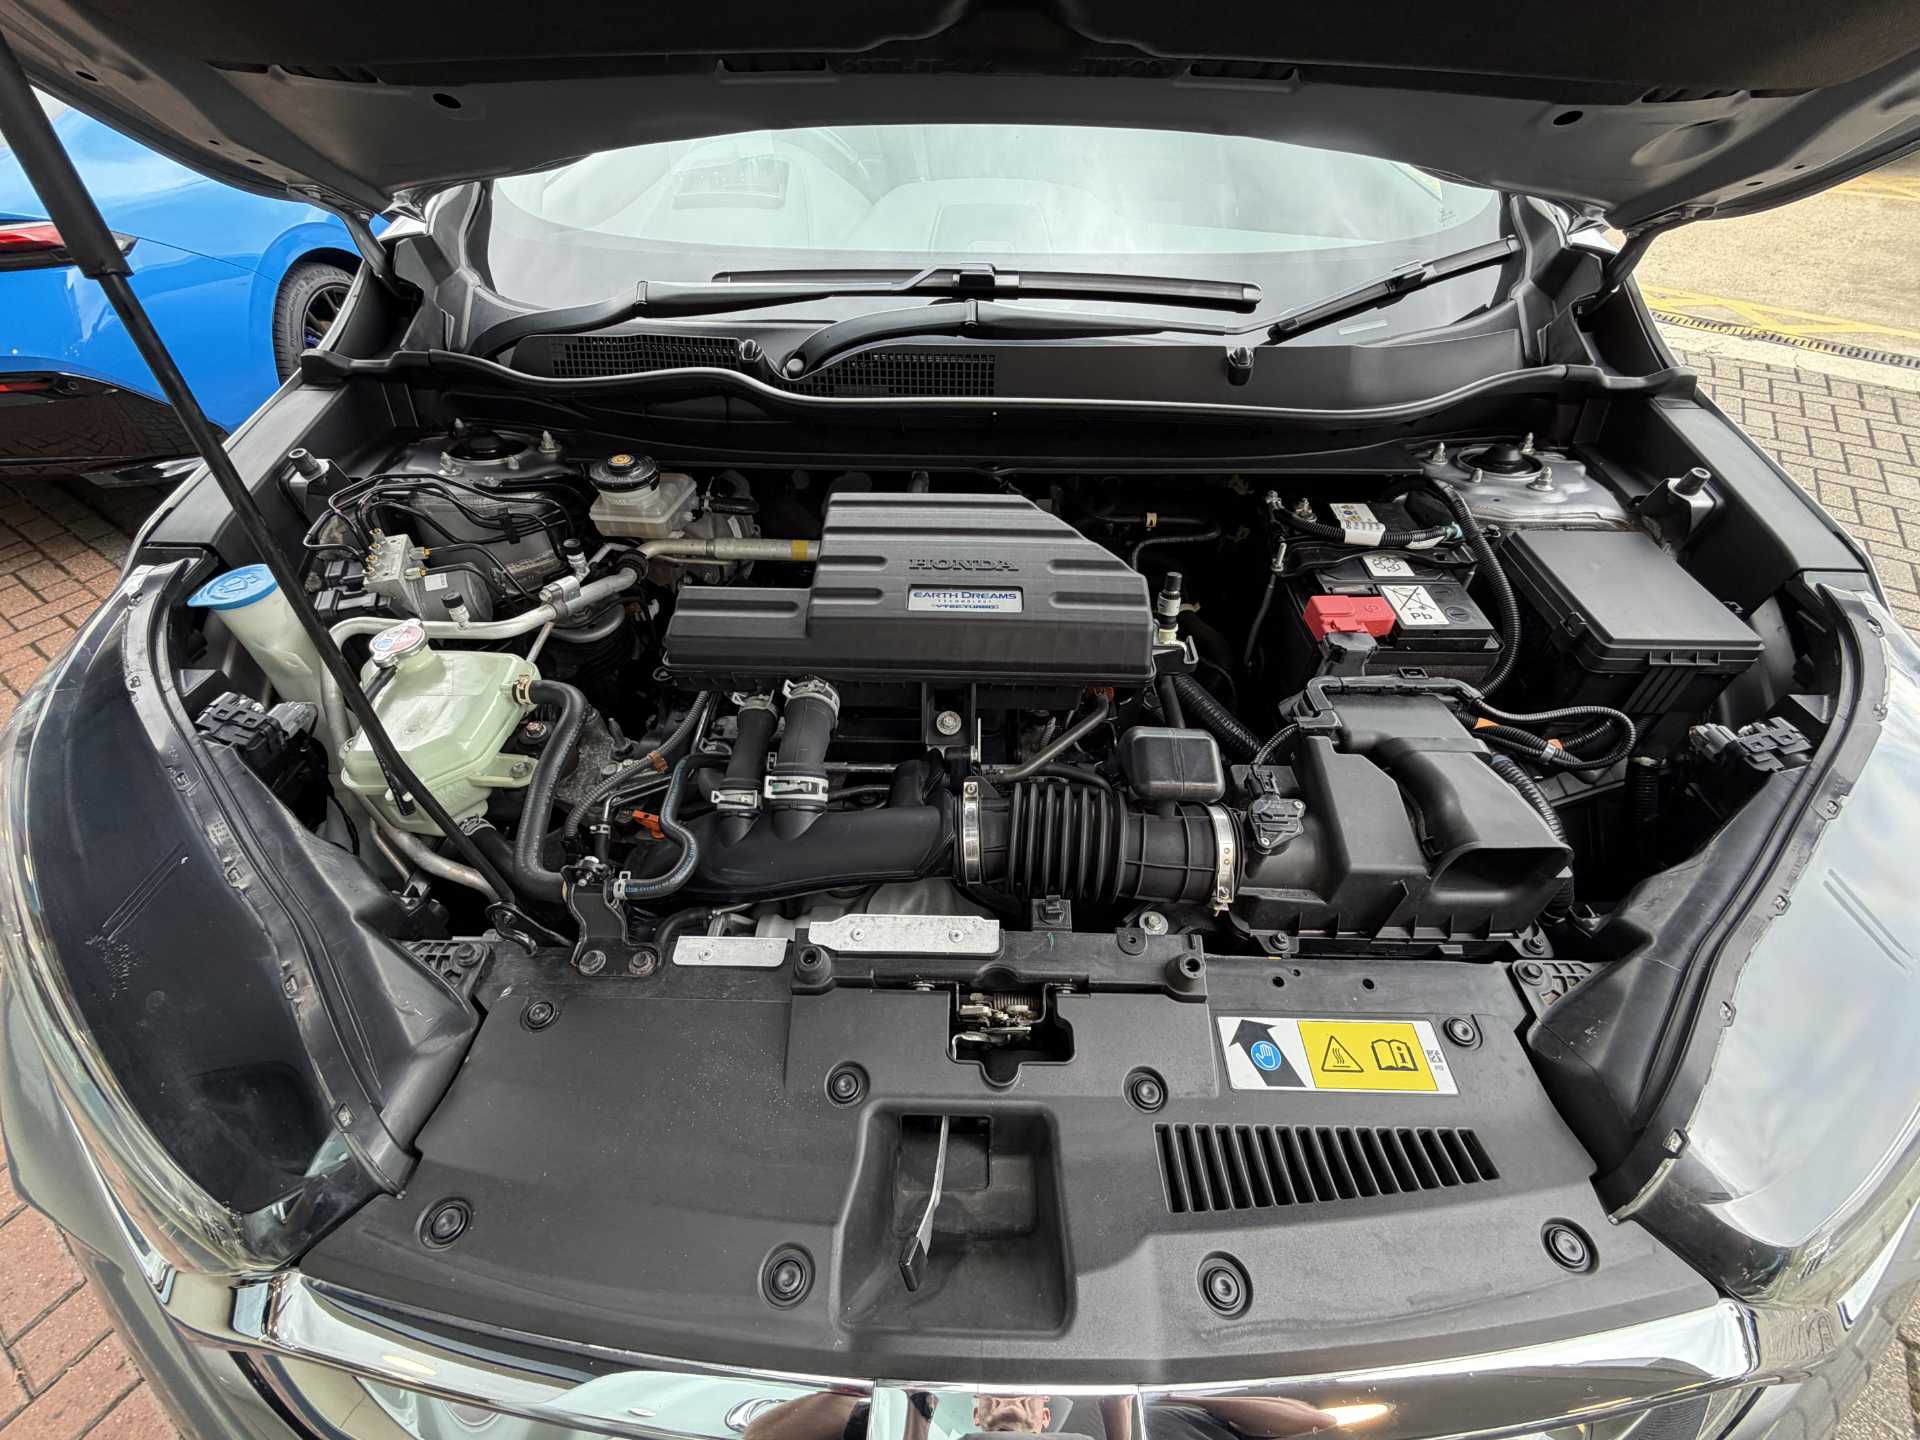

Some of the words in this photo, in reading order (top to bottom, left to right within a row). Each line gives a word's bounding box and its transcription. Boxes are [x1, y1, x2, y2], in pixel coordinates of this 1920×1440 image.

[908, 559, 1019, 571] HONDA
[961, 591, 1017, 599] DREAMS
[1410, 612, 1433, 620] Pb
